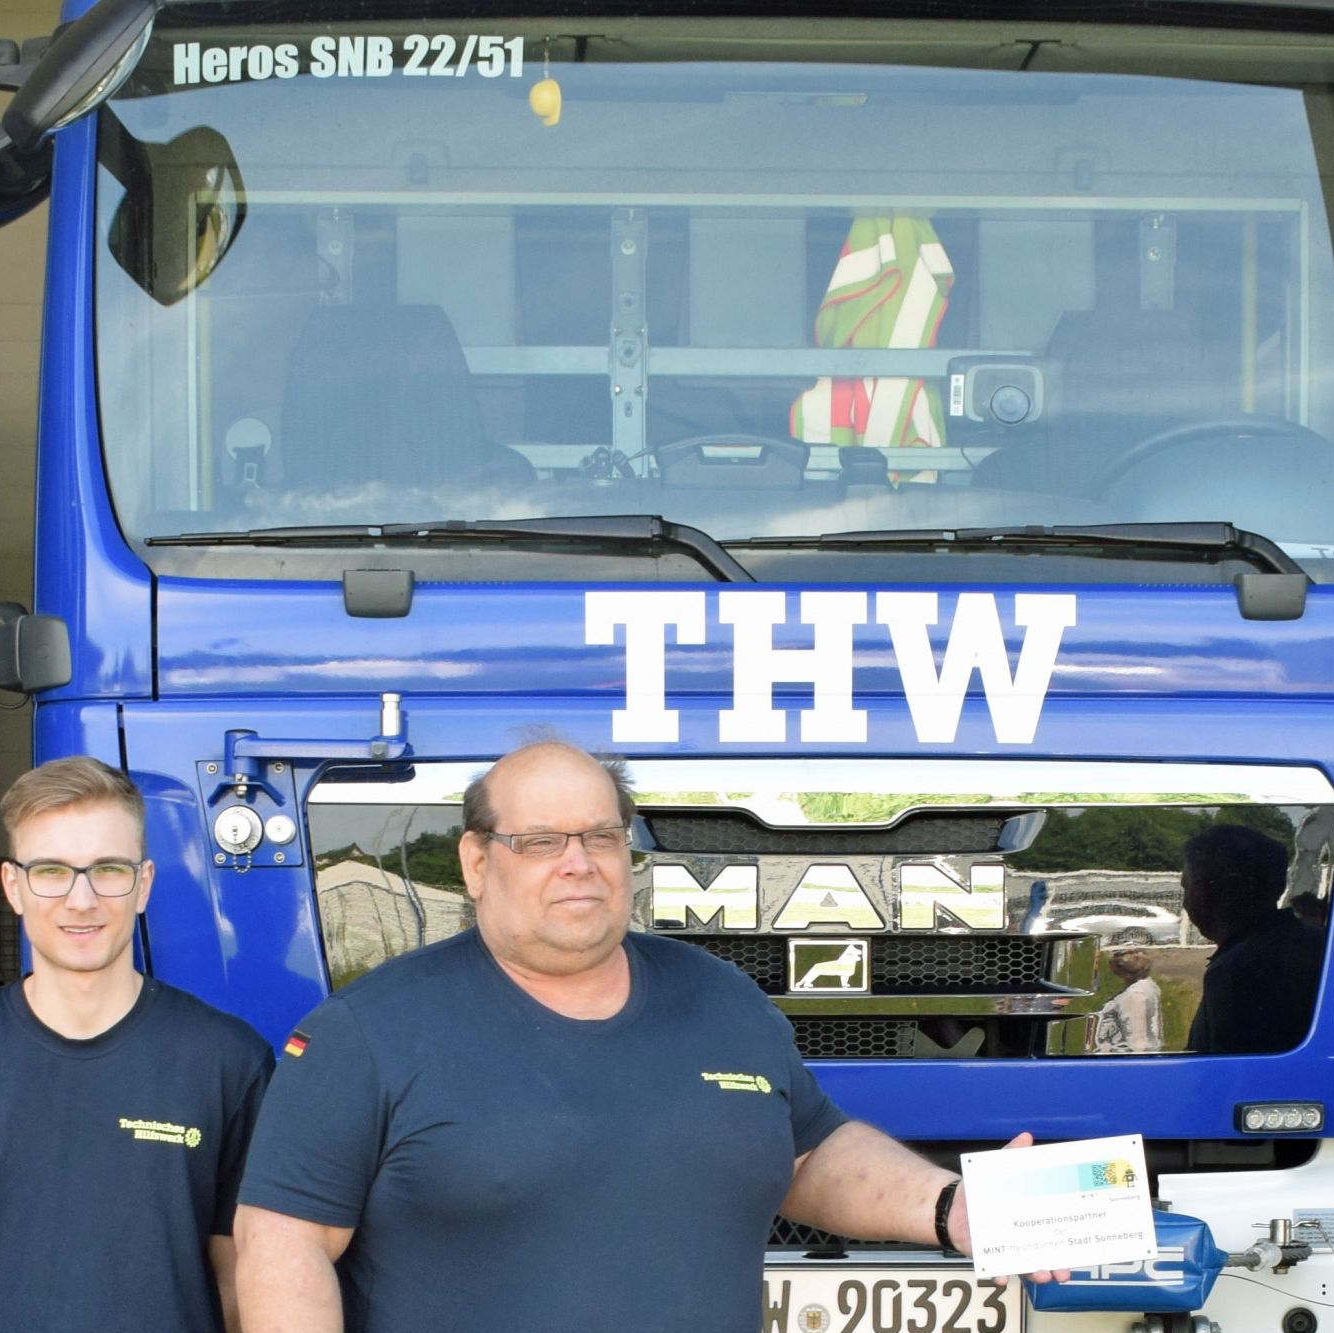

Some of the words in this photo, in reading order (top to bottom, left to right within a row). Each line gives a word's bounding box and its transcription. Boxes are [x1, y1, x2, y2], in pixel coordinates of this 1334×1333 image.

[173, 42, 299, 85] Heros
[310, 36, 394, 78] SNB
[403, 34, 525, 78] 22/51
[585, 591, 1077, 744] THW
[651, 863, 1006, 930] MAN
[118, 1118, 186, 1134] Technisches
[134, 1129, 185, 1144] Hilfswerk
[1013, 1211, 1107, 1228] Kooperationspartner
[1067, 1235, 1092, 1247] Stadt
[1094, 1230, 1144, 1244] Sonneberg
